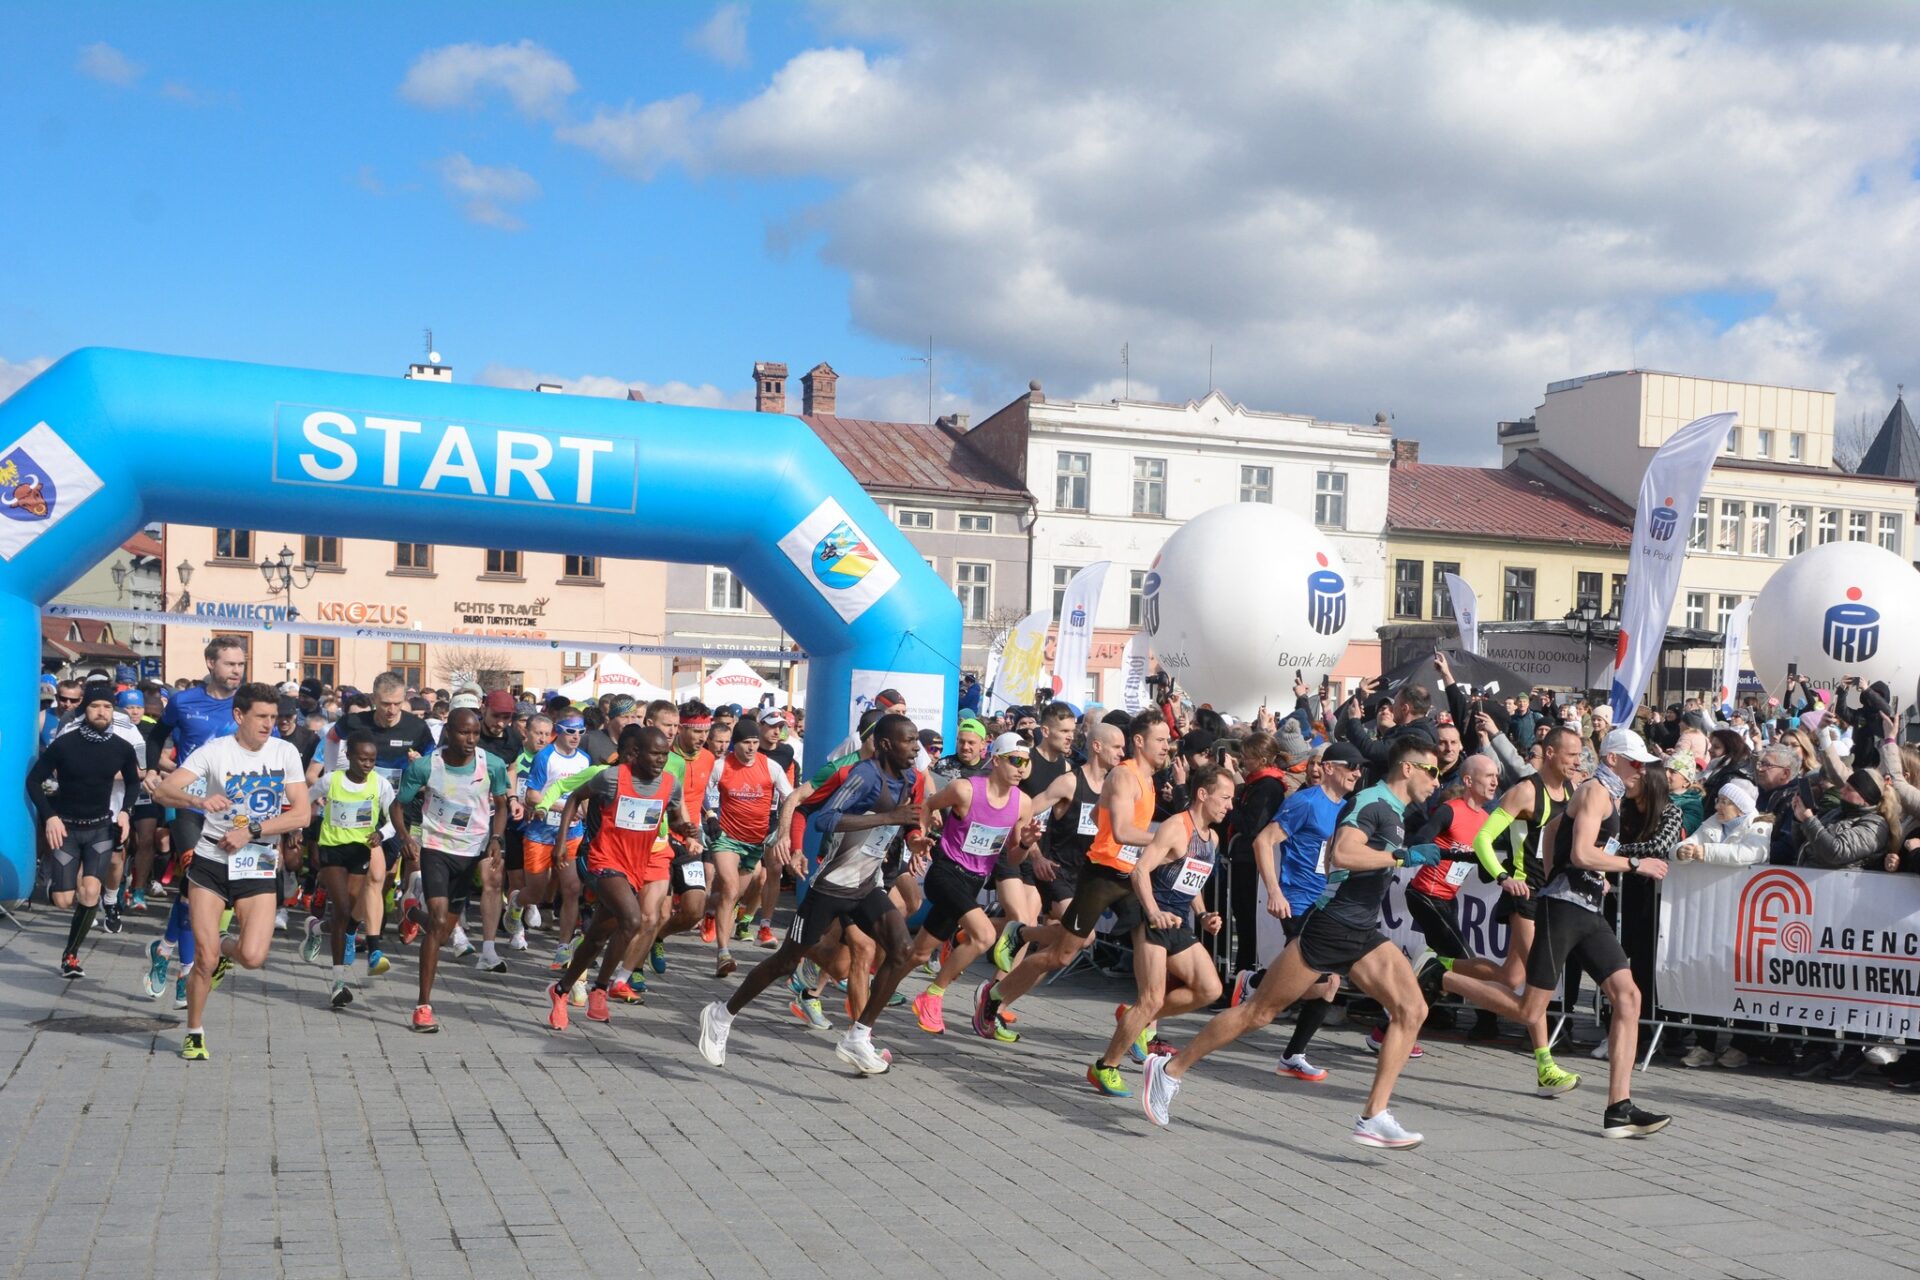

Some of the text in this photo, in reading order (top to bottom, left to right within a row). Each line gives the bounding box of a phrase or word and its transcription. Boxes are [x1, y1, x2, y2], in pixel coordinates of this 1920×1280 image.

[299, 411, 613, 504] START
[454, 602, 546, 616] ICHTIS TRAVEL
[1307, 570, 1346, 635] PKO
[463, 615, 537, 627] BIURO TURYSTYCZNE
[1822, 603, 1880, 663] PKO
[1278, 652, 1313, 667] Bank
[1487, 648, 1586, 664] MARATON DOOKOŁA
[255, 793, 269, 812] 5
[340, 811, 347, 820] 6
[437, 808, 444, 817] 5
[628, 810, 636, 820] 4
[875, 836, 884, 847] 2
[970, 835, 990, 848] 341
[235, 856, 254, 869] 540
[1454, 867, 1465, 877] 16
[1820, 926, 1918, 956] AGENC
[1769, 957, 1846, 990] SPORTU
[1852, 964, 1859, 991] I
[1733, 997, 1836, 1027] Andrzej
